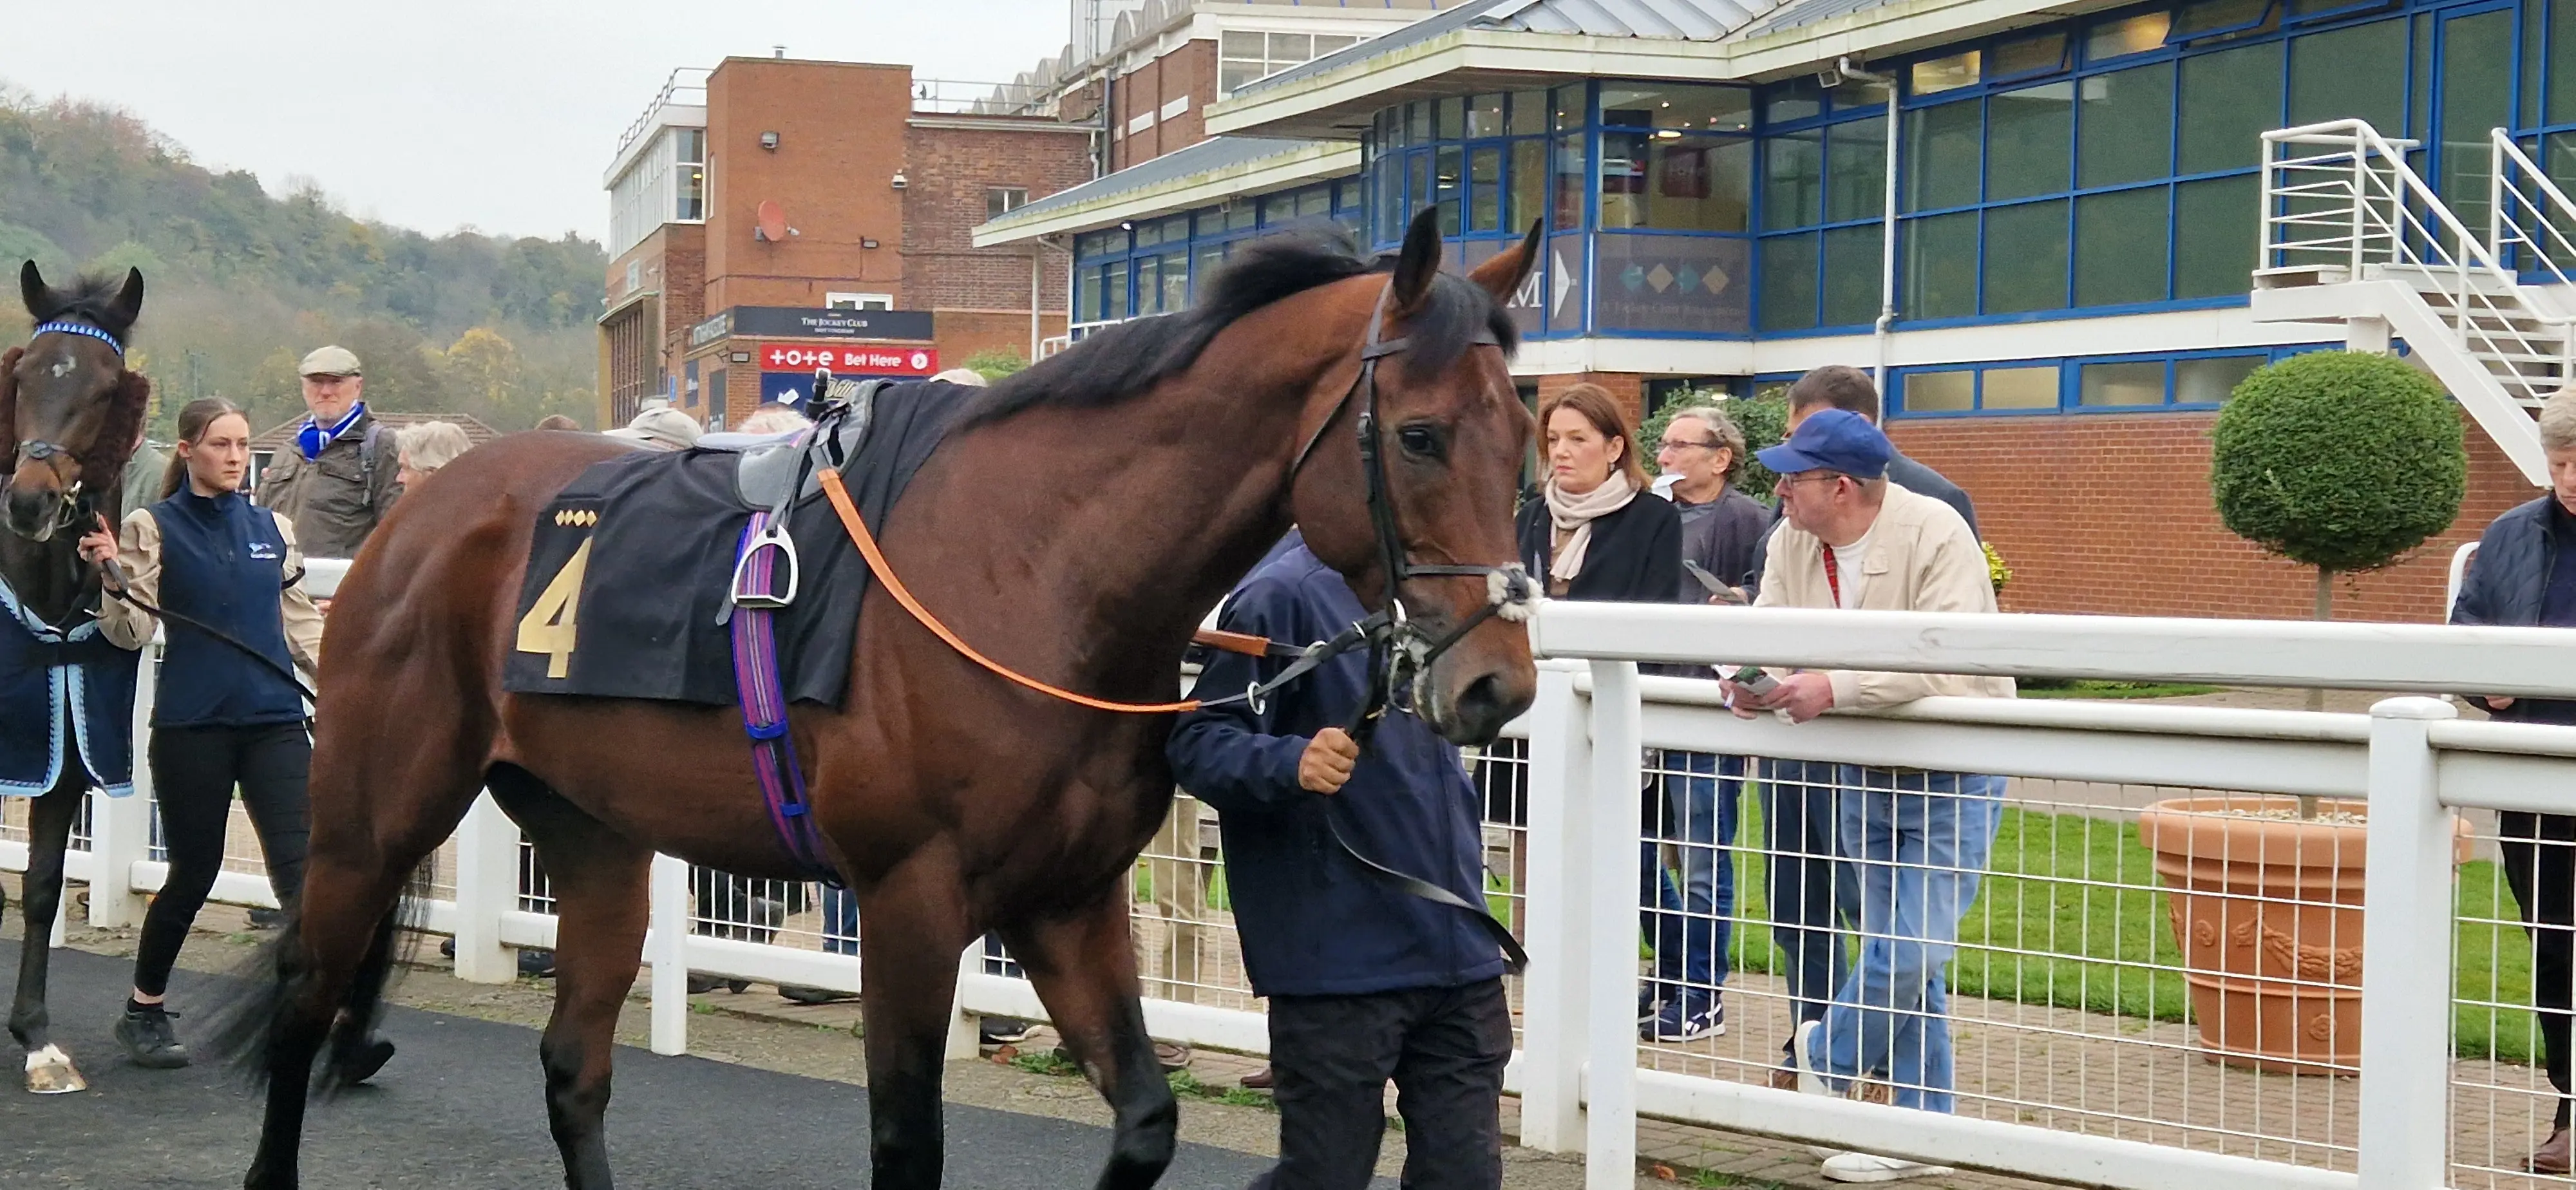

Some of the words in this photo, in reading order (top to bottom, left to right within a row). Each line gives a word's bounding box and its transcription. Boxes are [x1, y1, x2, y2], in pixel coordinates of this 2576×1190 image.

[770, 350, 834, 366] tote
[844, 353, 866, 366] Bet
[869, 354, 901, 367] Here
[516, 536, 593, 678] 4
